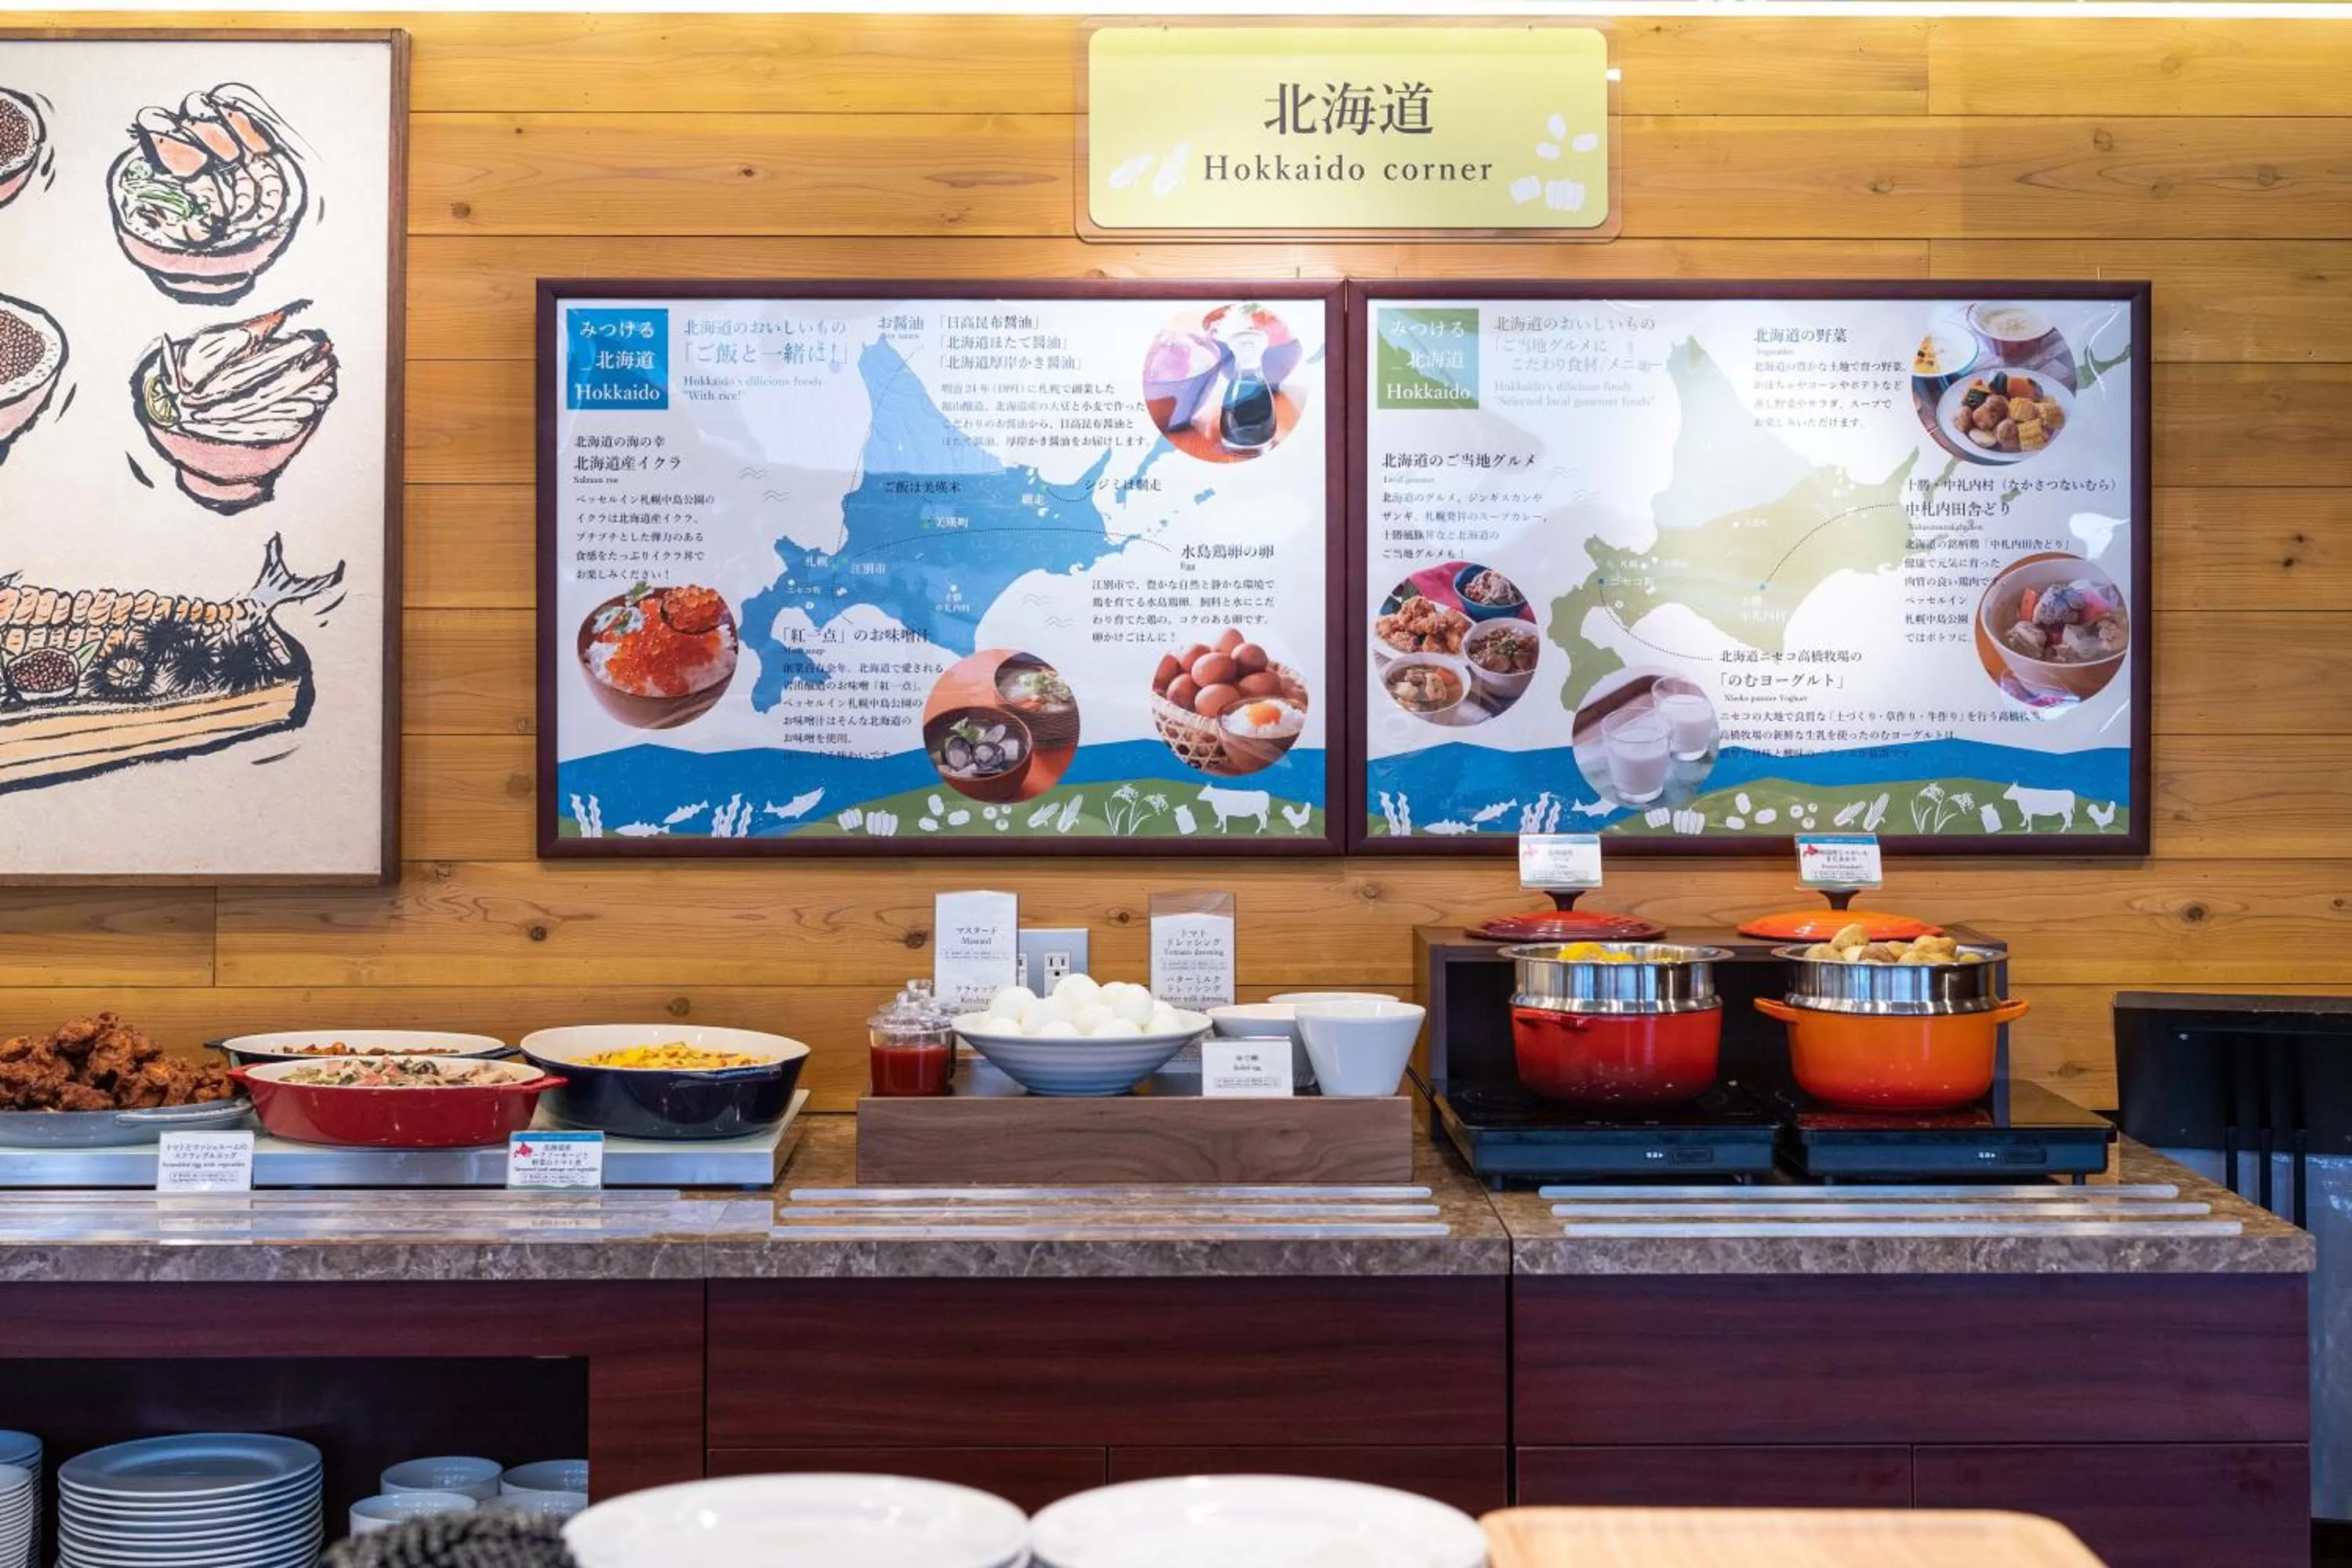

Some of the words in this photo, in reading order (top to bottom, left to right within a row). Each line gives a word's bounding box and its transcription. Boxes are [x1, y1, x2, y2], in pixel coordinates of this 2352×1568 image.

[1264, 81, 1434, 136] 北海道
[1203, 154, 1367, 183] Hokkaido
[1385, 160, 1493, 183] corner
[579, 320, 654, 338] みつける
[683, 319, 846, 335] 北海道のおいしいもの
[877, 315, 924, 330] お醤油
[1389, 320, 1465, 338] みつける
[1494, 316, 1655, 332] 北海道のおいしいもの
[1754, 328, 1847, 343] 北海道の野菜
[575, 384, 659, 401] Hokkaido
[1386, 383, 1471, 399] Hokkaido
[575, 435, 665, 448] 北海道の海の幸
[574, 456, 681, 470] 北海道産イクラ
[1381, 452, 1534, 468] 北海道のご当地グルメ
[1906, 502, 2010, 517] 中札内田舎どり
[1722, 673, 1843, 688] 「のむヨーグルト」
[1182, 929, 1206, 938] トマト
